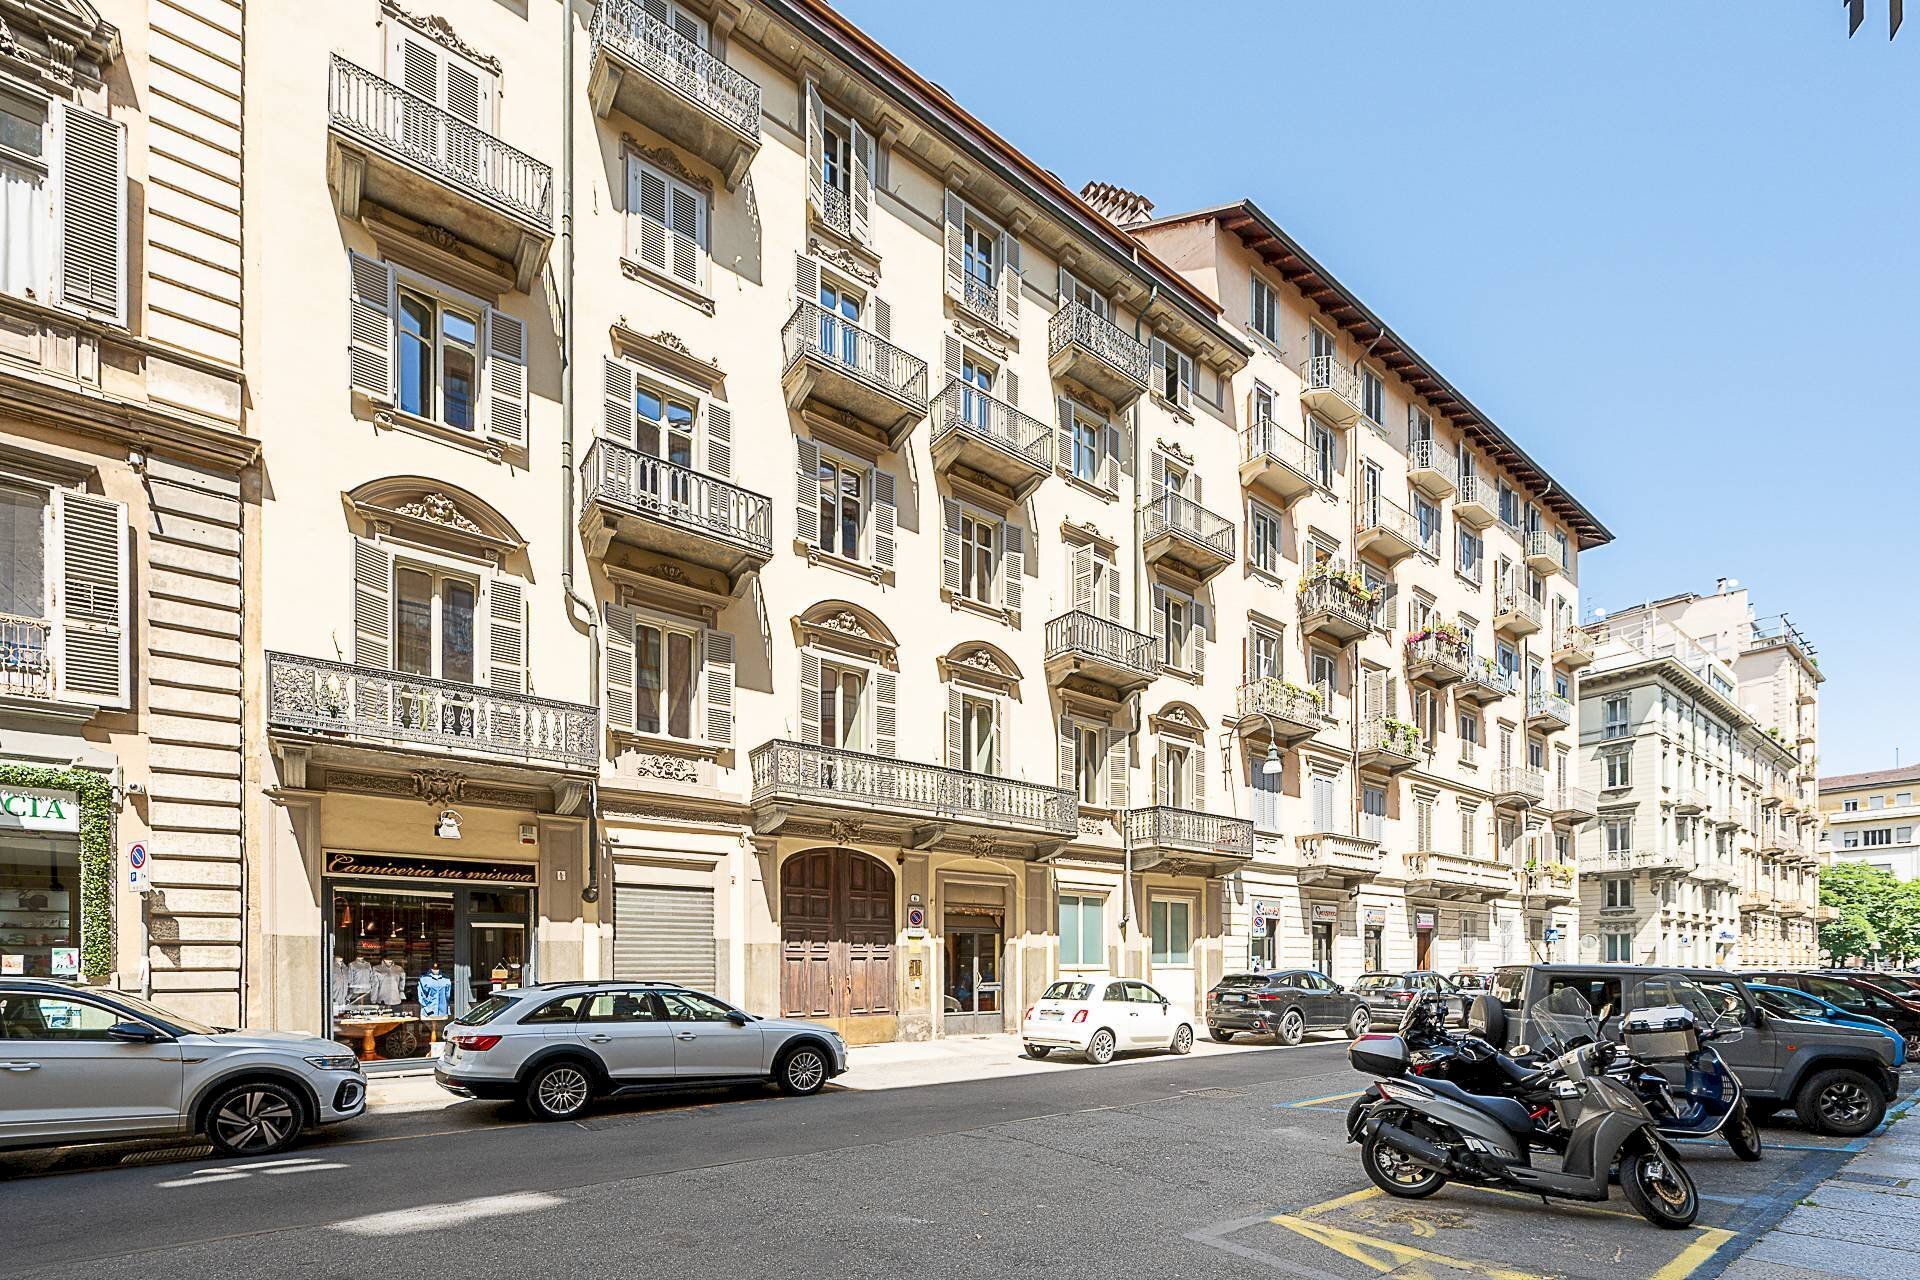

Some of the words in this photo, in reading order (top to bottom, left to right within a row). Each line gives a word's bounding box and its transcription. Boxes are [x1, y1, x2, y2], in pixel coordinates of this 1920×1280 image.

[328, 854, 435, 876] Camiceria
[438, 868, 463, 878] su
[466, 868, 533, 881] misura
